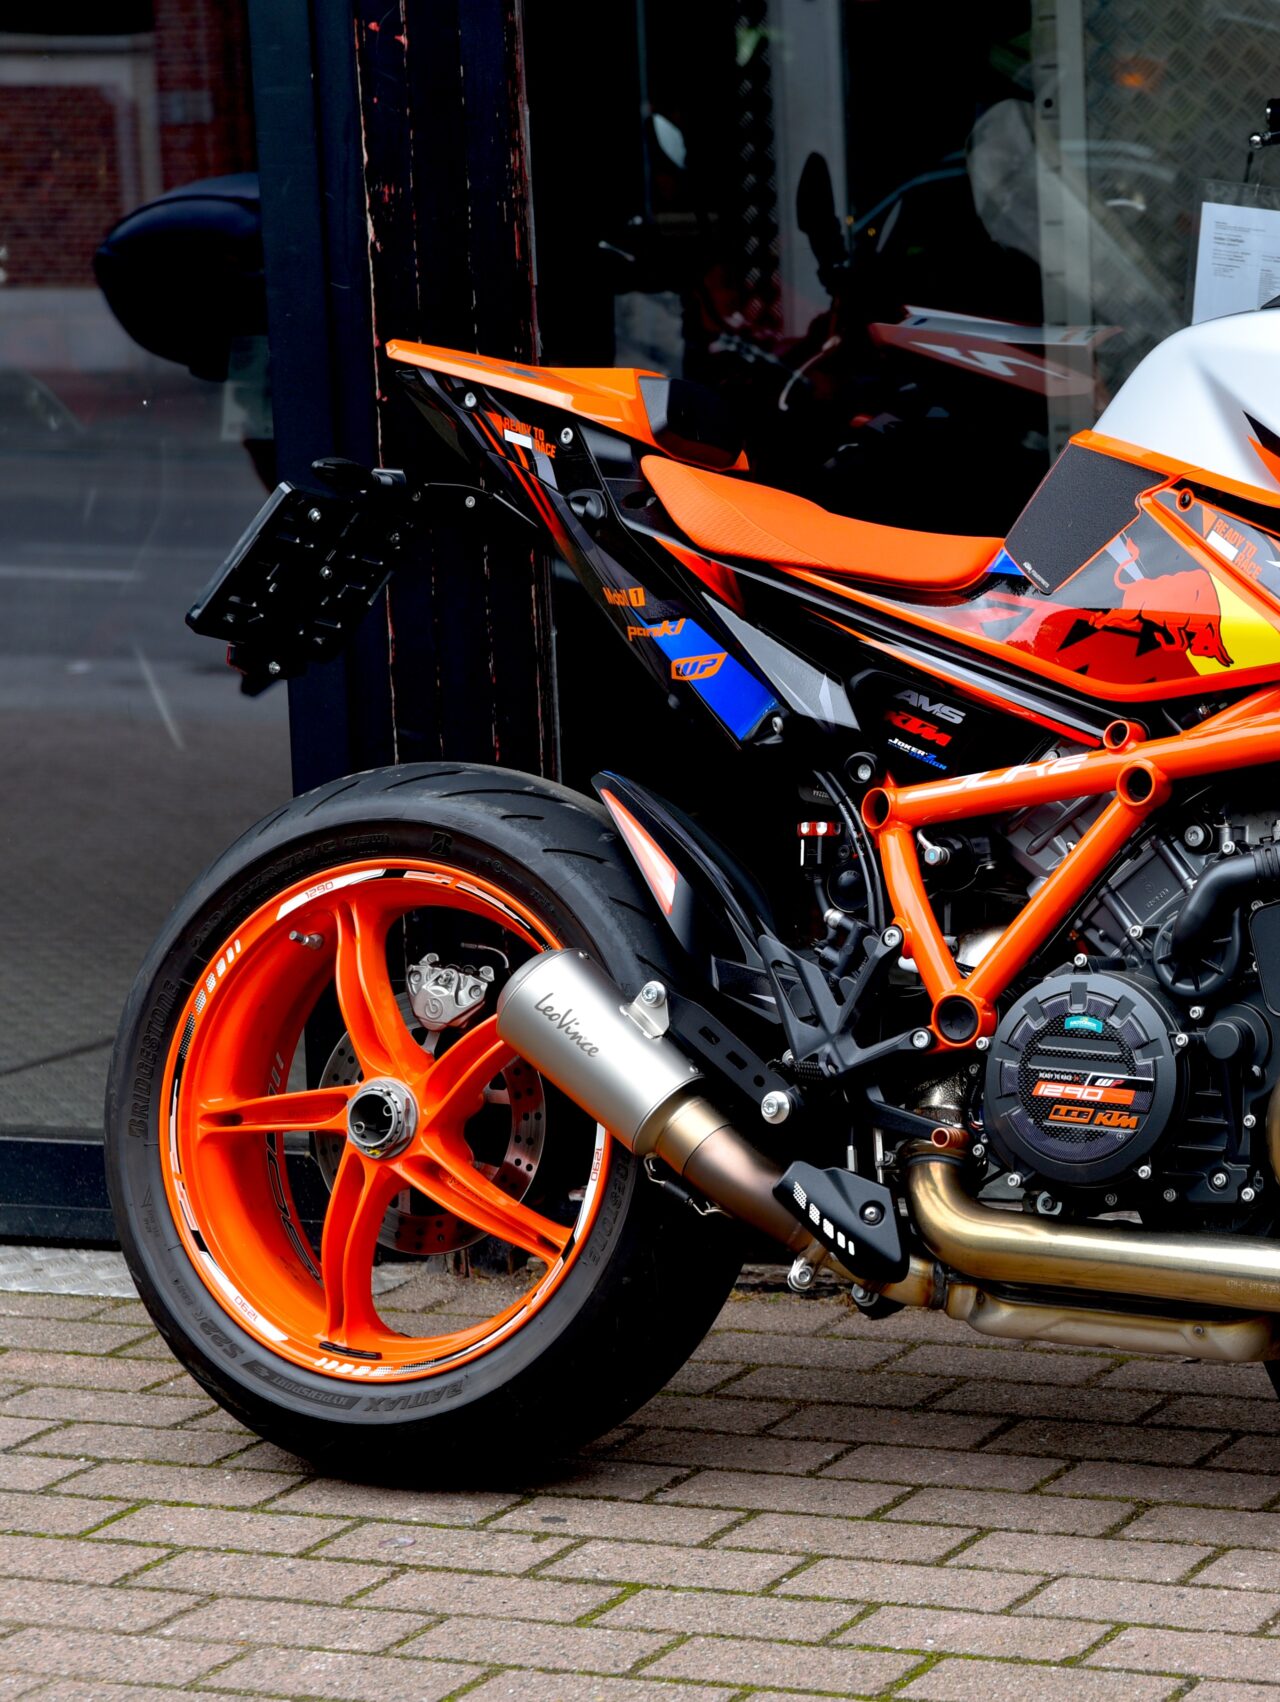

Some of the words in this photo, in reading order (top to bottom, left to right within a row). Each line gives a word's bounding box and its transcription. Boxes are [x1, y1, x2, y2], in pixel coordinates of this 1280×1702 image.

[503, 417, 531, 436] READY
[533, 427, 545, 441] TO
[534, 440, 557, 459] RACE
[1213, 518, 1247, 548] READY
[1243, 540, 1258, 561] TO
[1233, 551, 1263, 581] RACE
[894, 689, 967, 725] AMS
[885, 711, 953, 747] KTM
[305, 881, 334, 899] 1290
[534, 992, 600, 1058] LeoVince
[127, 977, 181, 1140] BRIDGESTONE
[1038, 1083, 1104, 1101] 1290
[1094, 1078, 1124, 1087] WP
[1094, 1110, 1139, 1129] KTM
[589, 1147, 603, 1182] 1290
[234, 1295, 259, 1323] 1290
[271, 1372, 349, 1406] HYPERSPORT
[364, 1378, 467, 1412] BATTLAX
